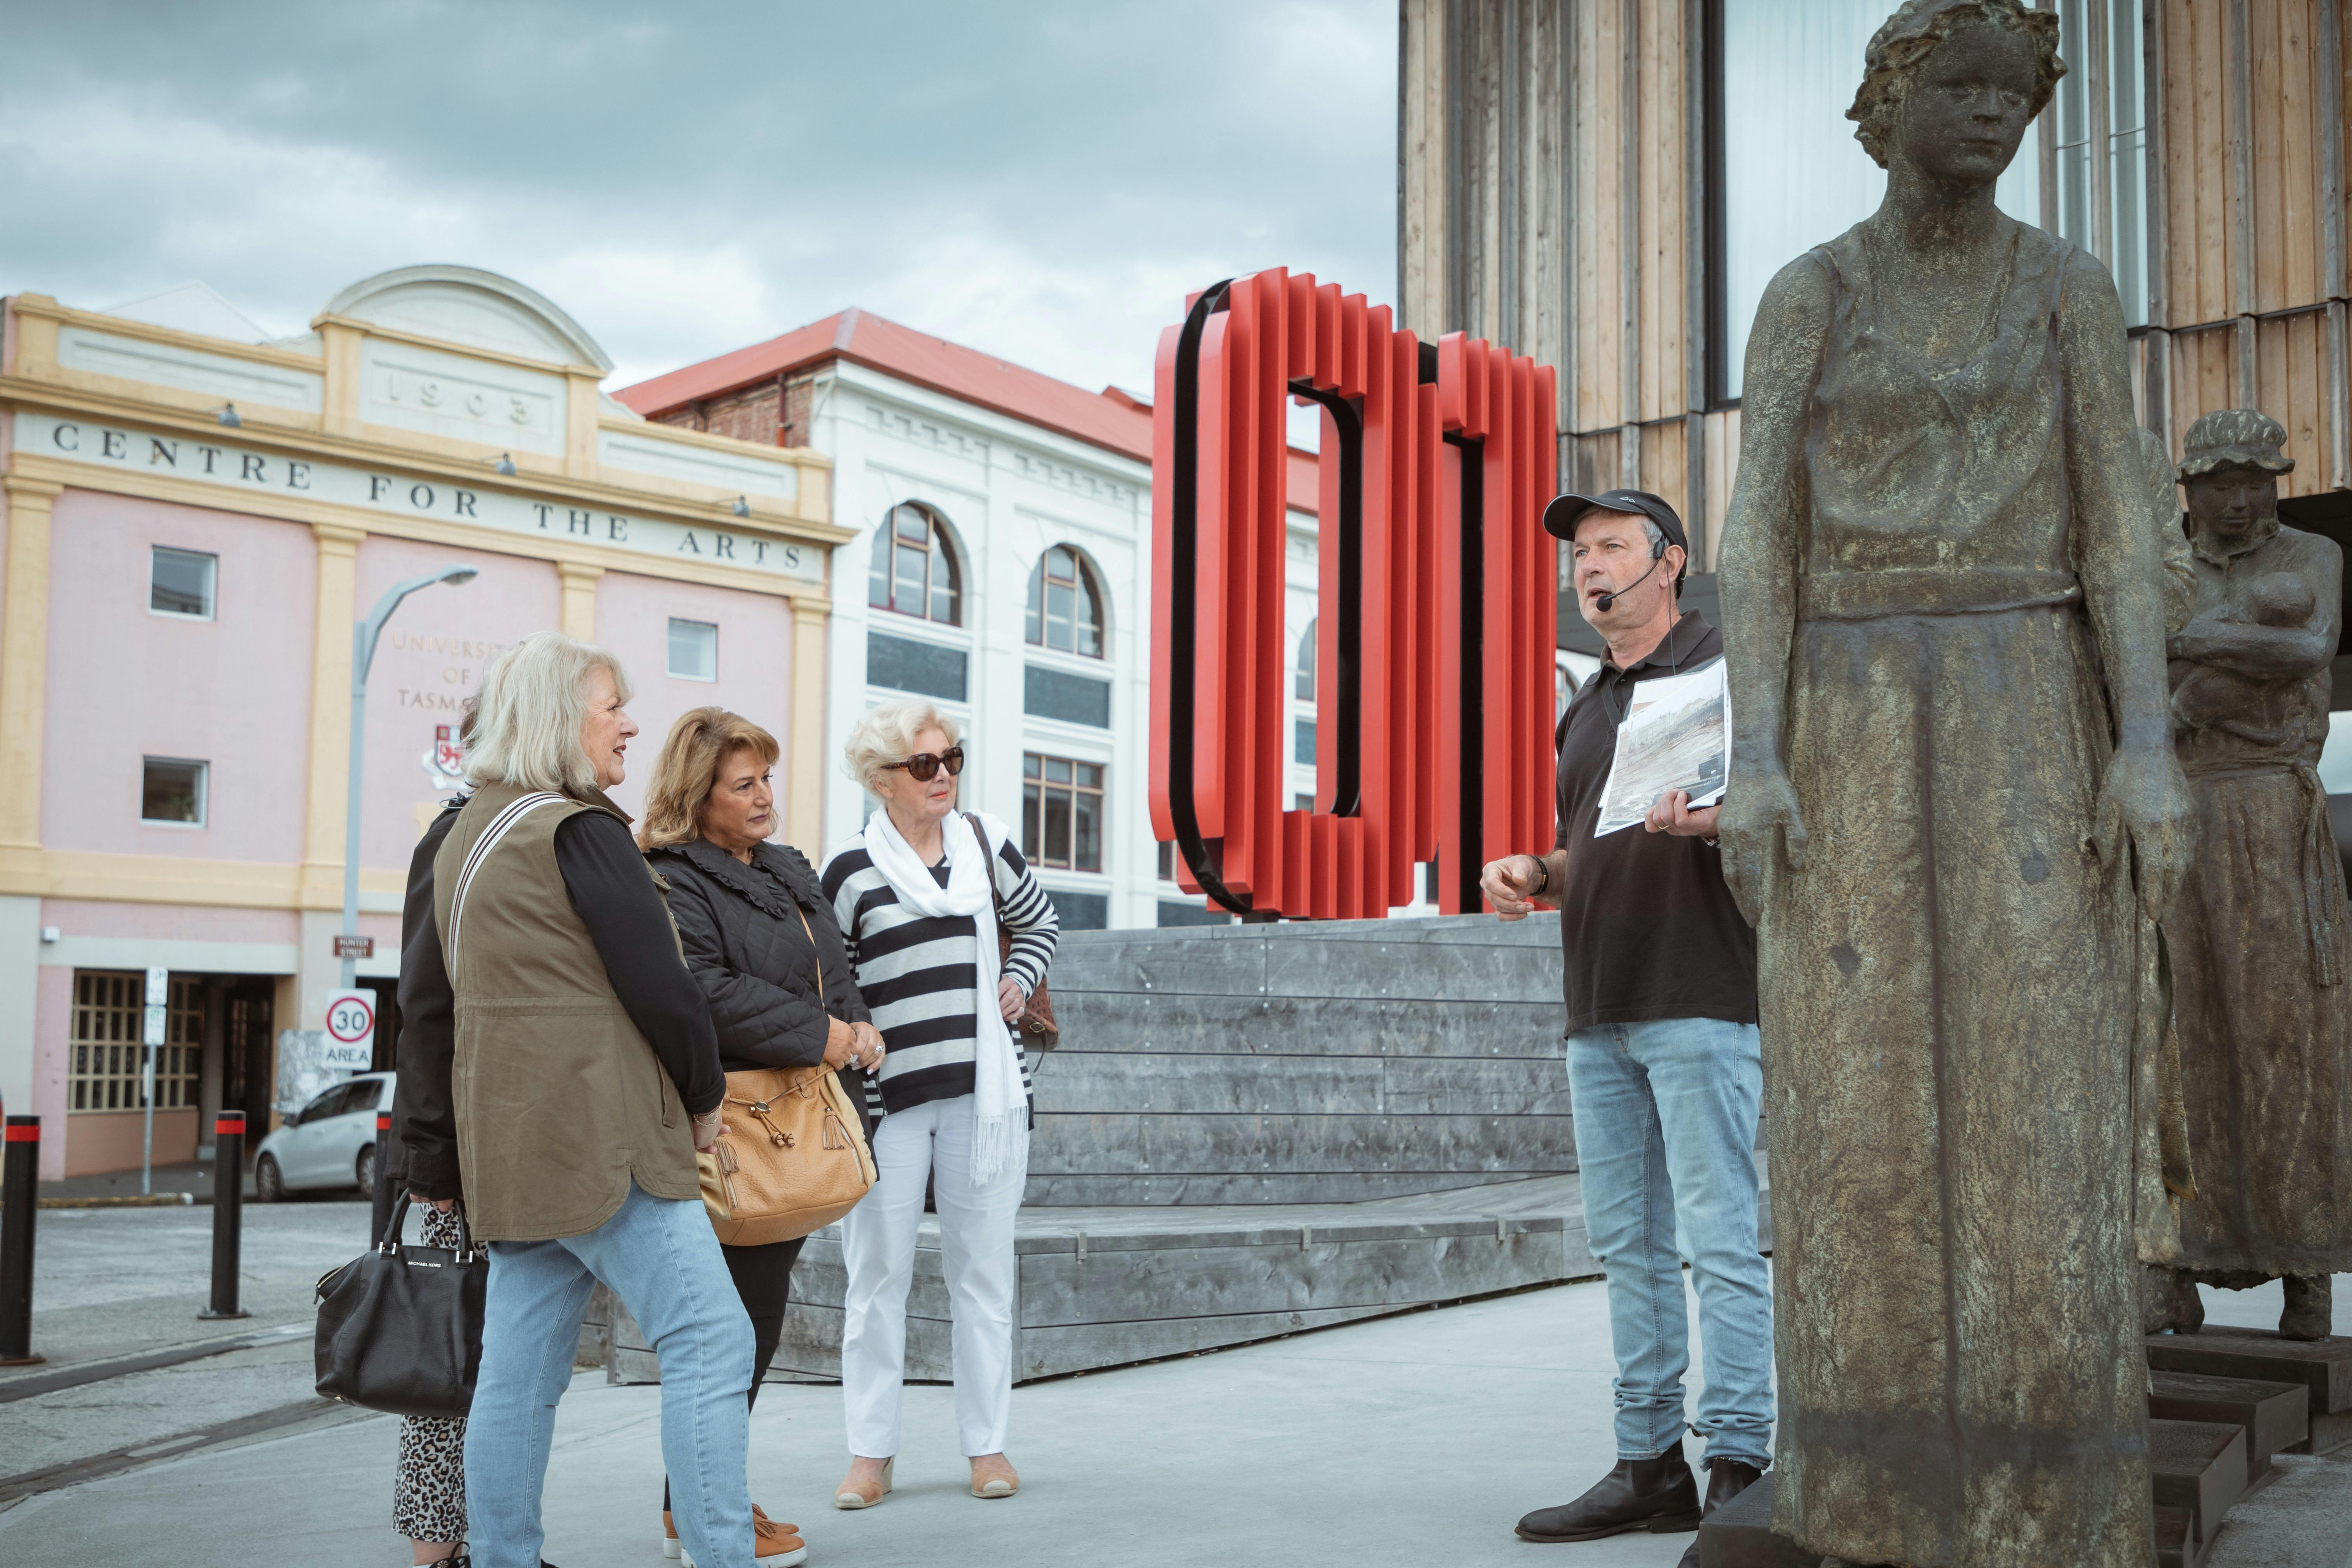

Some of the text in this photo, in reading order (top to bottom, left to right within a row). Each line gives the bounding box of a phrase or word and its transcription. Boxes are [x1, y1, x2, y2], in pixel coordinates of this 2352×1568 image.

[54, 423, 799, 568] CENTRE FOR THE ARTS
[443, 666, 470, 685] OF
[340, 938, 369, 947] HUNTER
[340, 947, 367, 956] STREET
[335, 1011, 366, 1031] 30
[327, 1049, 370, 1063] AREA
